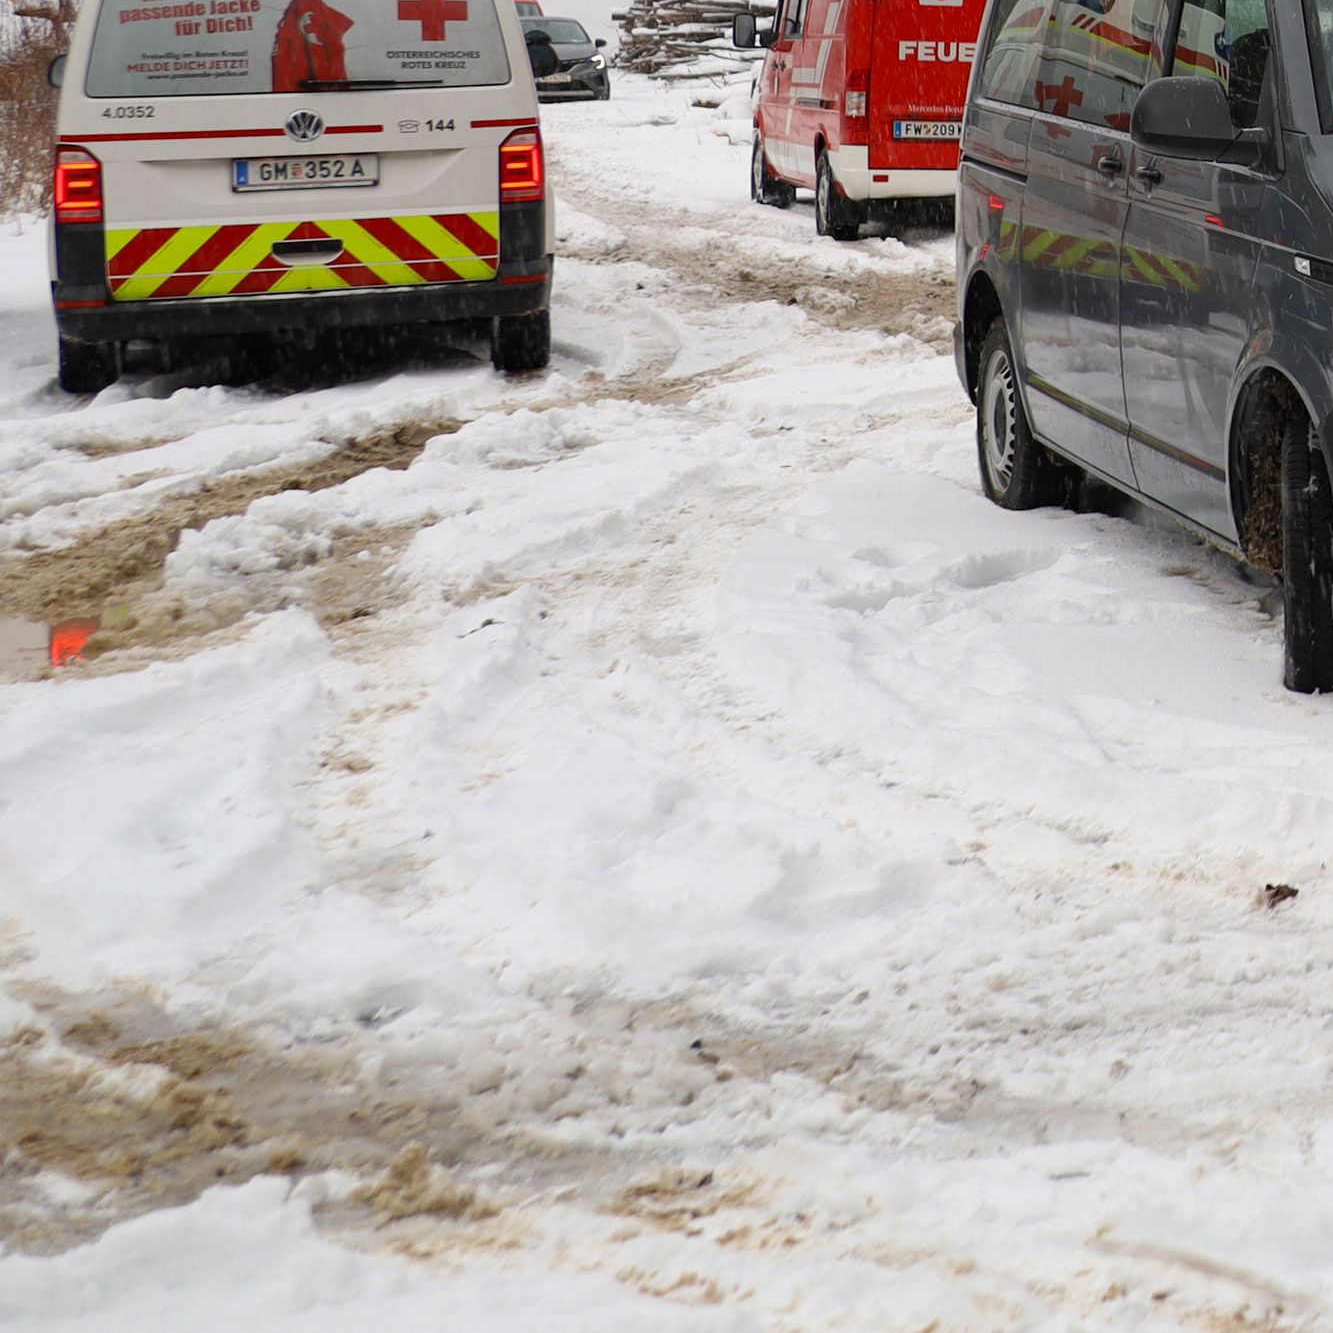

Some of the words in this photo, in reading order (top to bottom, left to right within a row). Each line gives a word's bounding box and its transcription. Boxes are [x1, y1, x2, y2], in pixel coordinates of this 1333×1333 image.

[119, 2, 206, 24] passende
[175, 20, 201, 36] für
[206, 16, 254, 34] Dich!
[386, 50, 481, 59] ÖSTERREICHISCHES
[127, 62, 170, 73] MELDE
[173, 61, 206, 72] DICH
[401, 61, 433, 69] ROTES
[434, 61, 467, 69] KREUZ
[101, 105, 155, 119] 4.0352
[425, 119, 455, 132] 144
[905, 123, 922, 135] FW
[932, 124, 955, 136] 209
[260, 163, 288, 181] GM
[305, 160, 345, 179] 352
[351, 159, 365, 177] A
